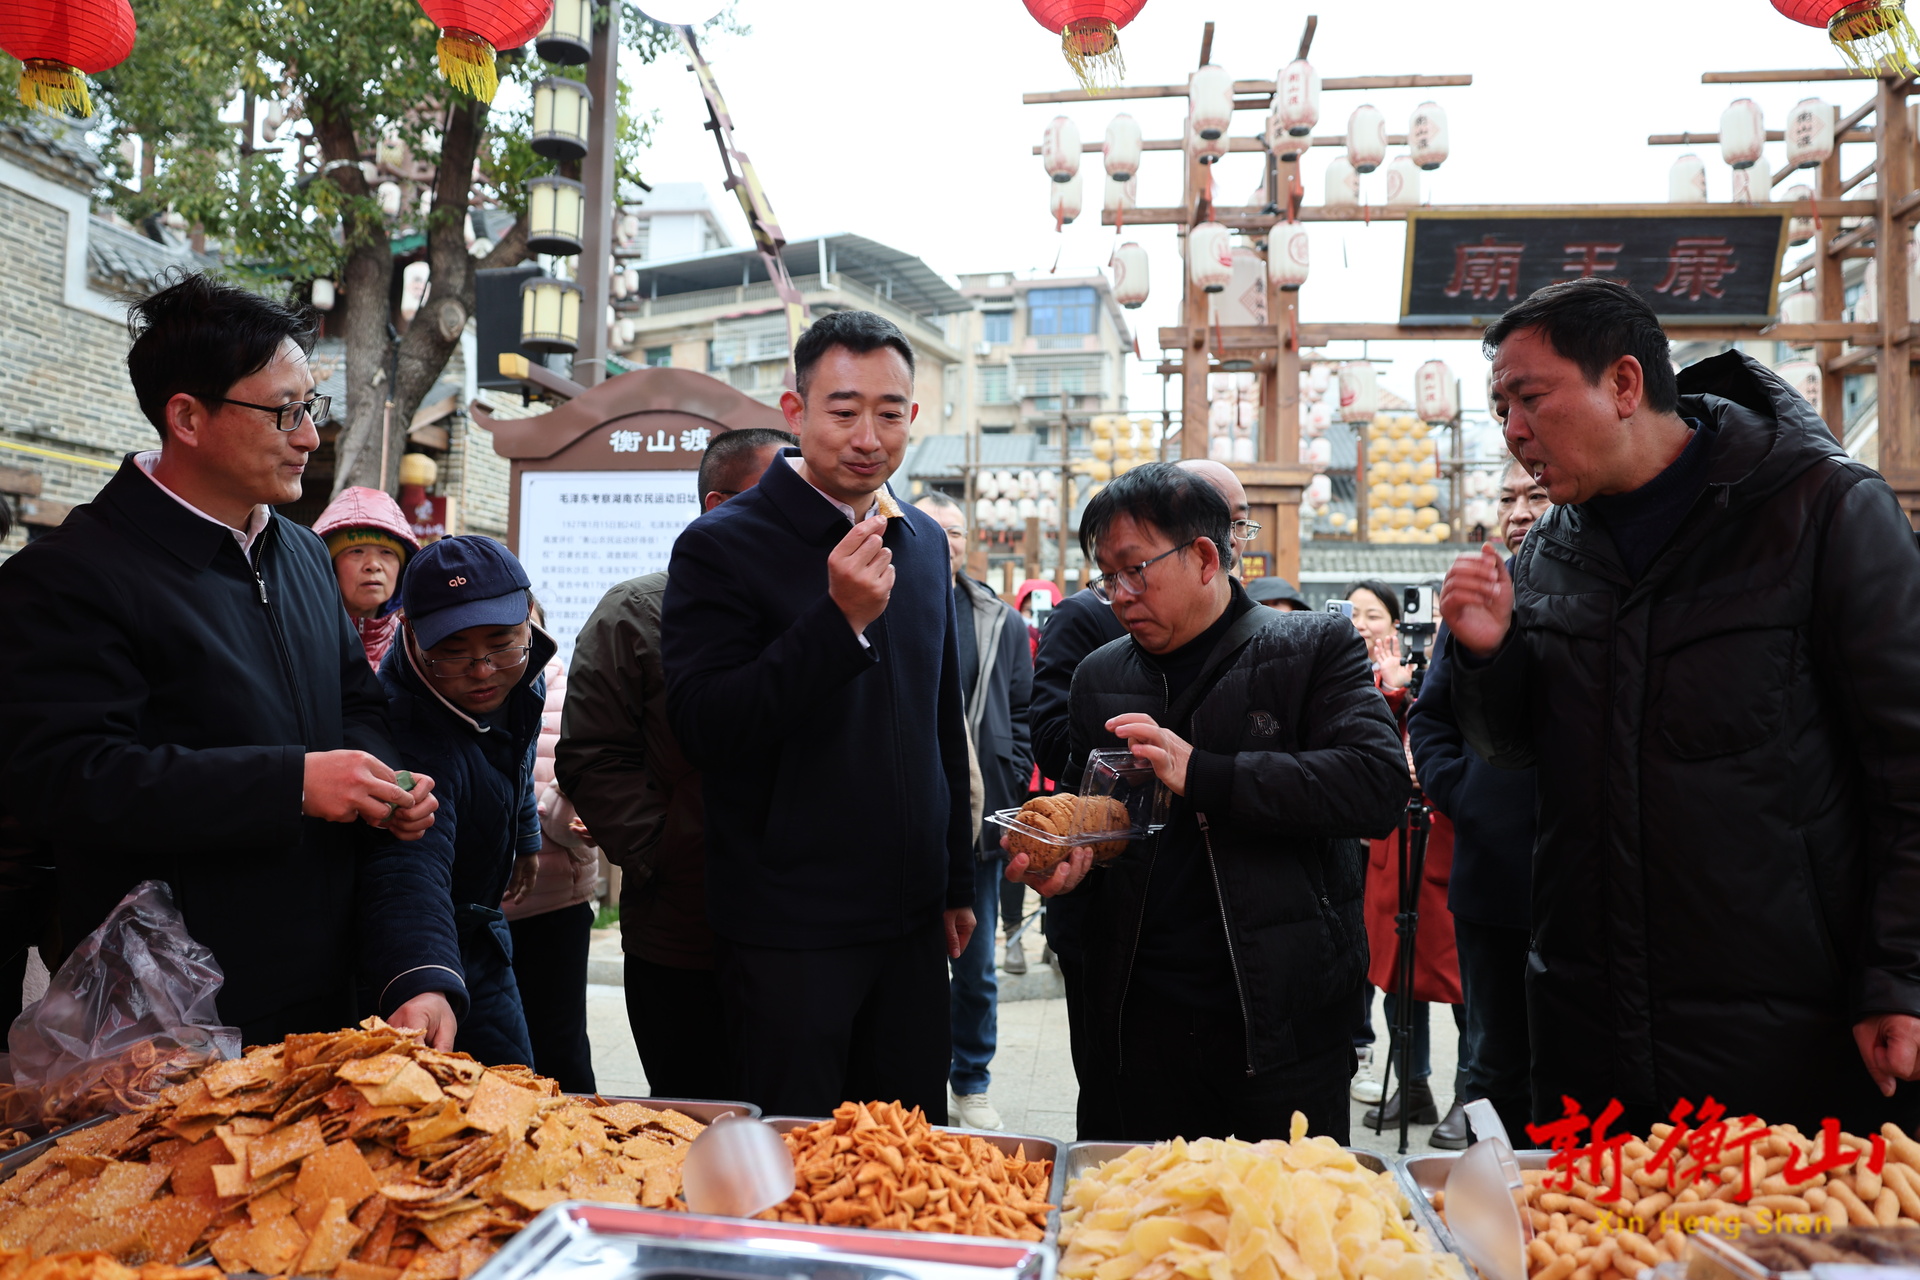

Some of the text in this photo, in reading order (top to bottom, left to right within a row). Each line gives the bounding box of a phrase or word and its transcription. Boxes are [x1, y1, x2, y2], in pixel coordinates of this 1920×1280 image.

[609, 427, 711, 453] 衡山渡
[559, 493, 697, 505] 毛泽东考察湖南农民运动旧址
